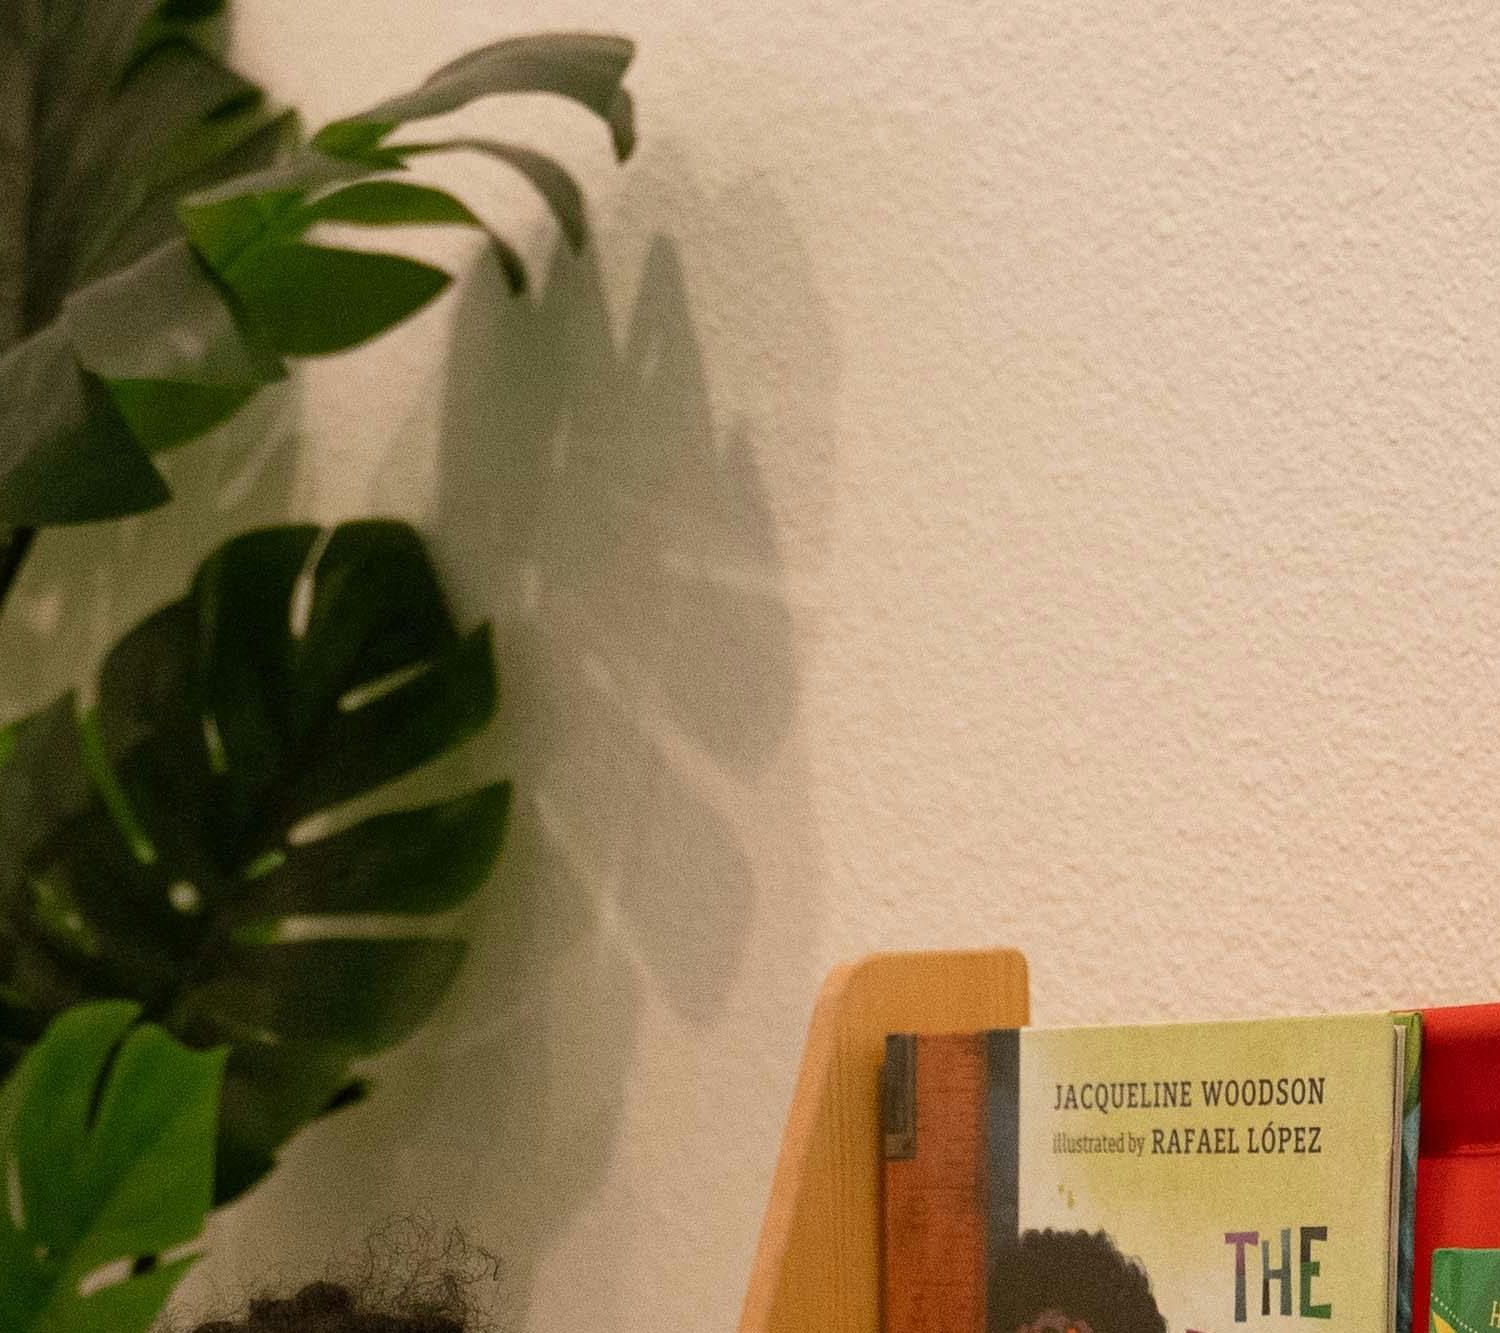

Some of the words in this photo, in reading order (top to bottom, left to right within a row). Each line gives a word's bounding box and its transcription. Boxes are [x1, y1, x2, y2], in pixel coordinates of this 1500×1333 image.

[1054, 1081, 1193, 1114] JACQUELINE
[1202, 1078, 1325, 1106] WOODSON
[1052, 1131, 1125, 1154] illustrated
[1128, 1133, 1146, 1157] by
[1151, 1127, 1239, 1154] RAFAEL
[1248, 1122, 1322, 1153] LÓPEZ
[1224, 1226, 1332, 1322] THE
